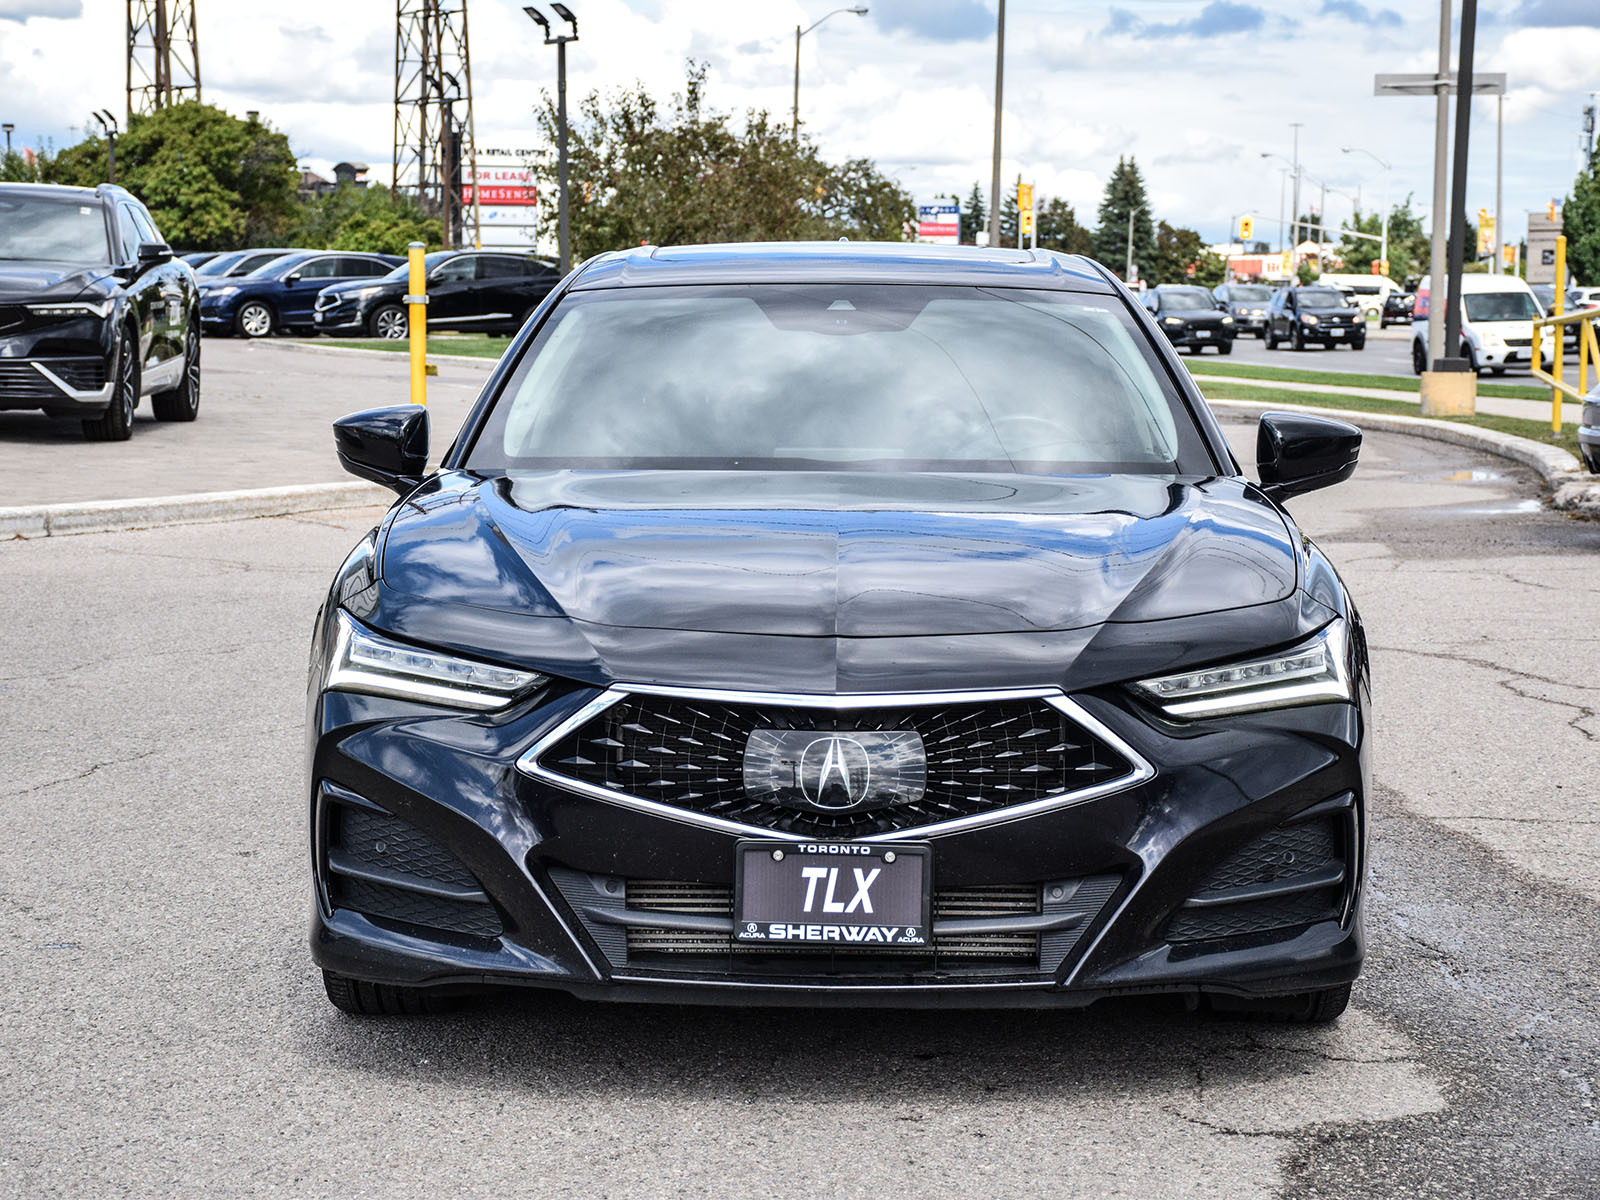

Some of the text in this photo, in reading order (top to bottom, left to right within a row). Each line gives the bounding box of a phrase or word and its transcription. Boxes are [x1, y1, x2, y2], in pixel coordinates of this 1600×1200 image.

[463, 187, 535, 199] HMESENSE
[798, 844, 871, 854] TORONTO
[801, 866, 882, 914] TLX
[769, 924, 899, 942] SHERWAY
